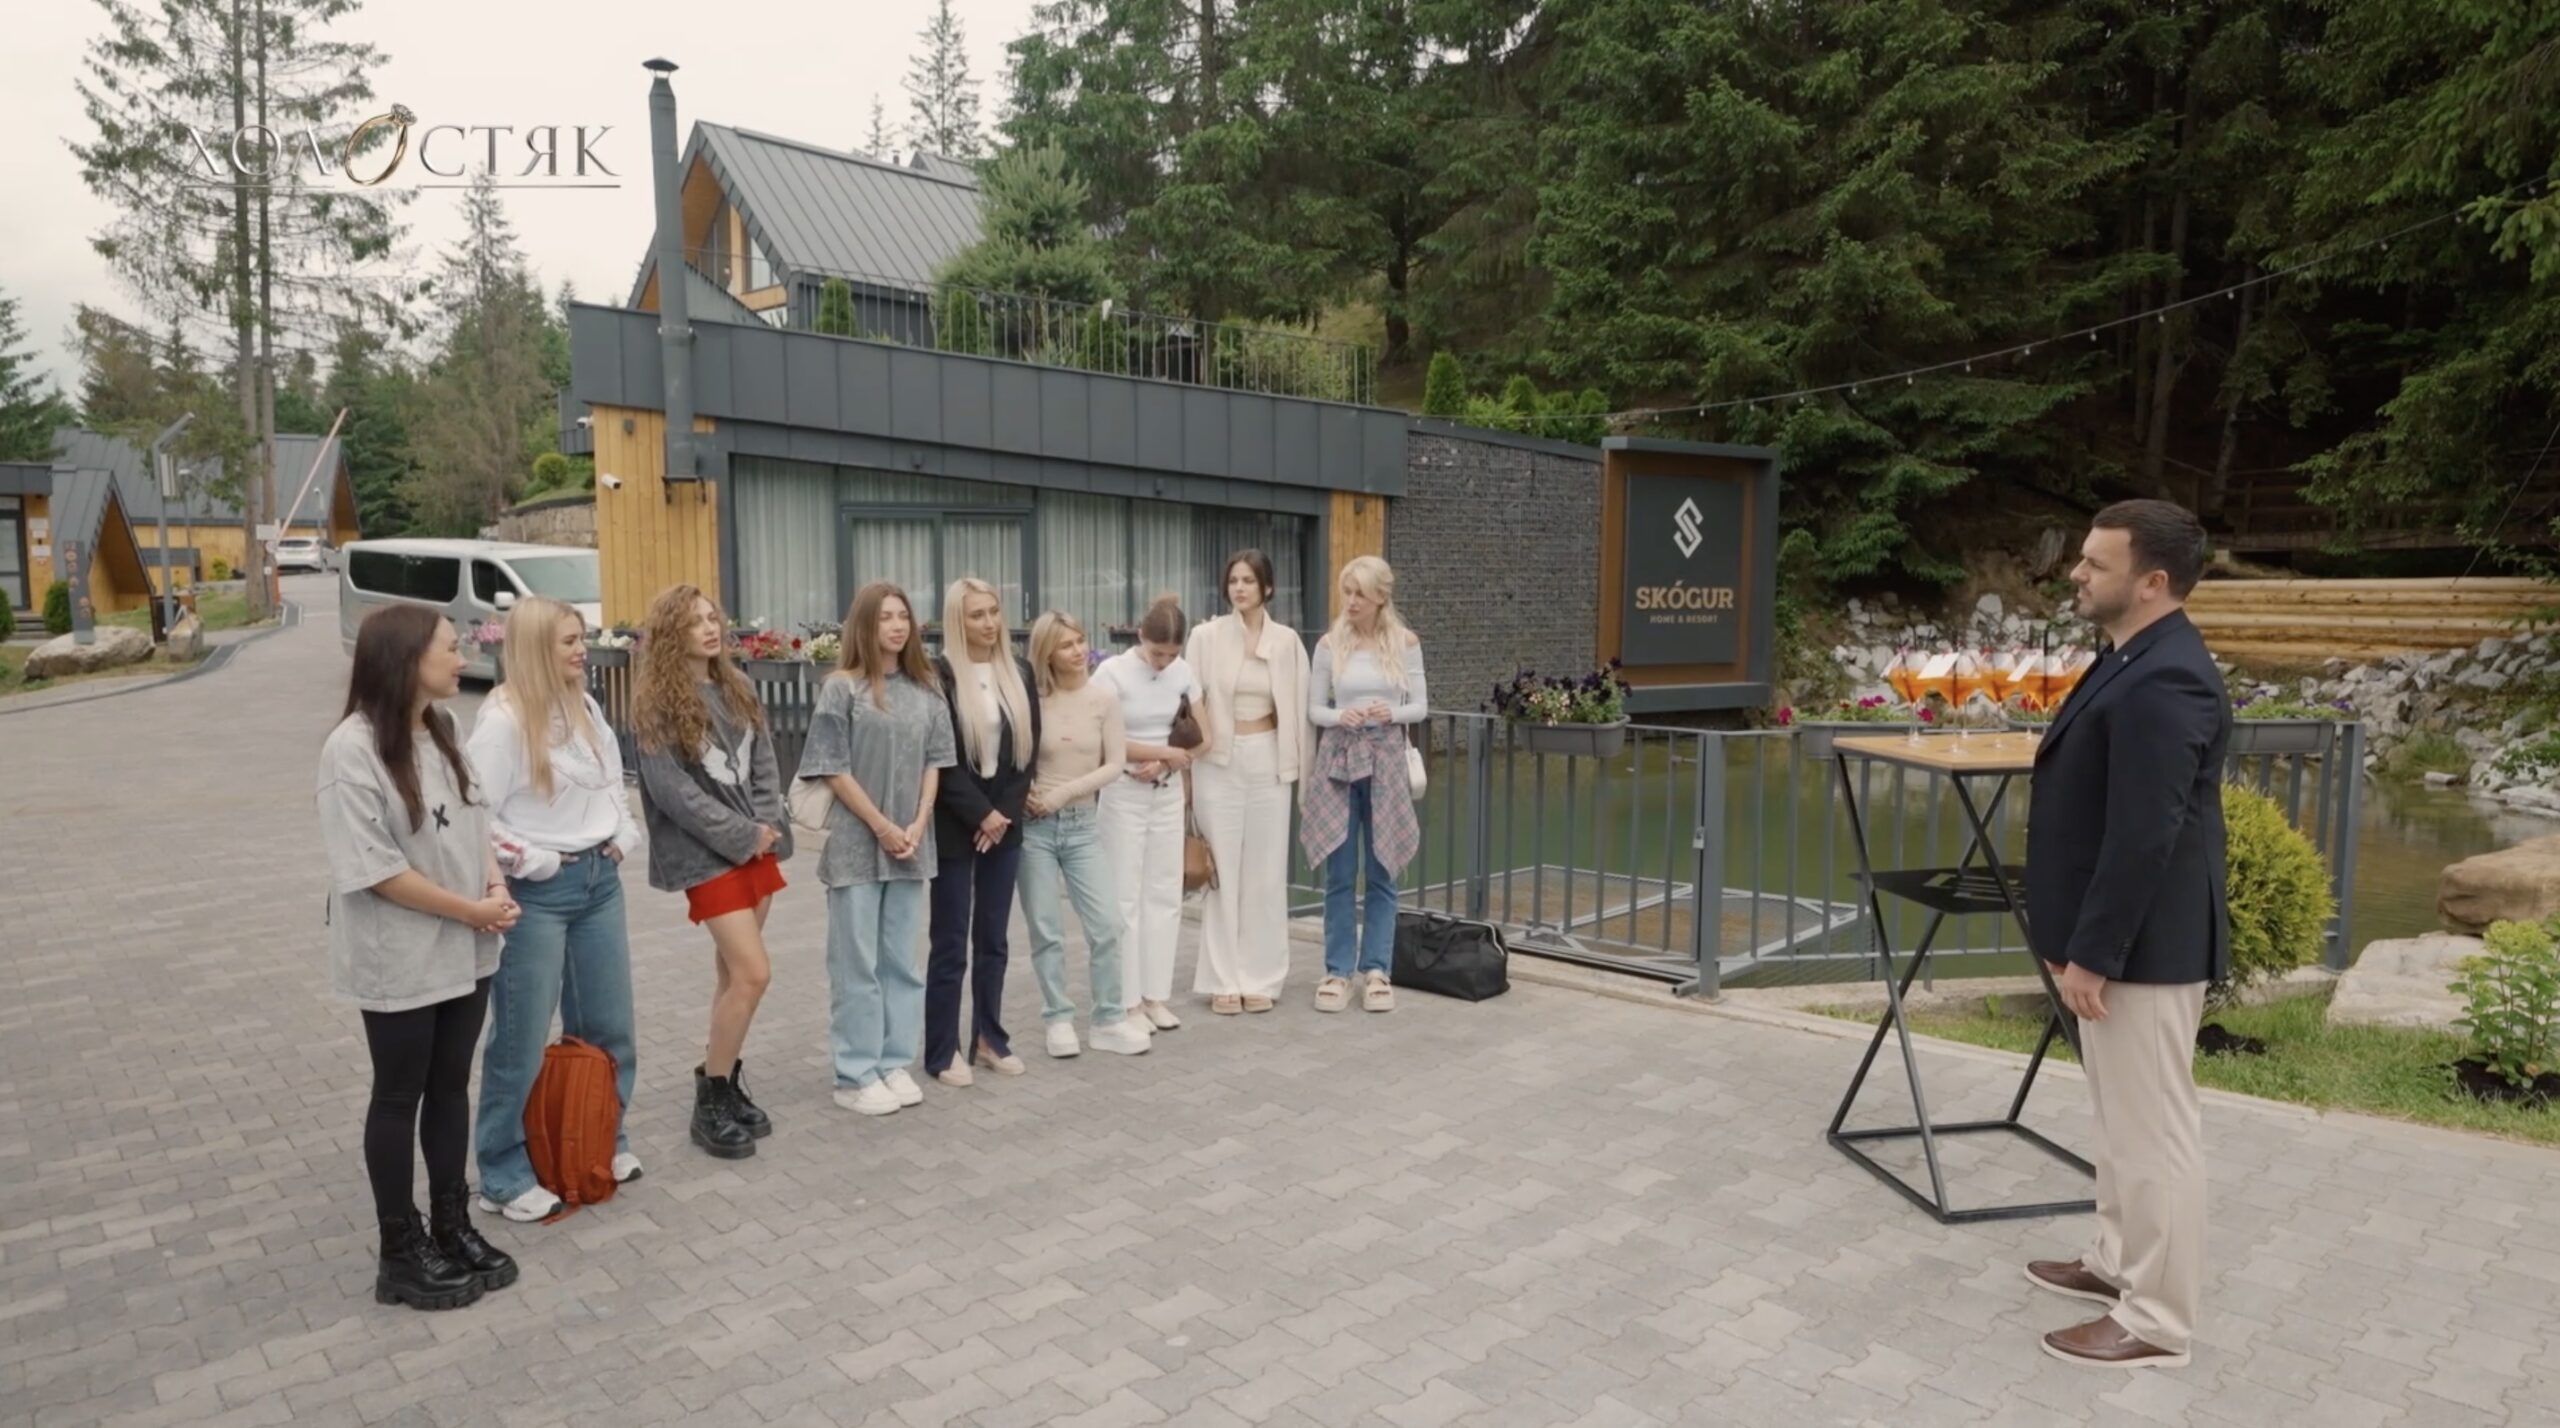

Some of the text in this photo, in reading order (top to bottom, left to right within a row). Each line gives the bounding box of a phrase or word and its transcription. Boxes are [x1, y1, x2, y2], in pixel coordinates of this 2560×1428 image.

[1635, 579, 1734, 610] SKÓGUR
[1649, 615, 1675, 624] HOME
[1686, 614, 1718, 624] RESORT
